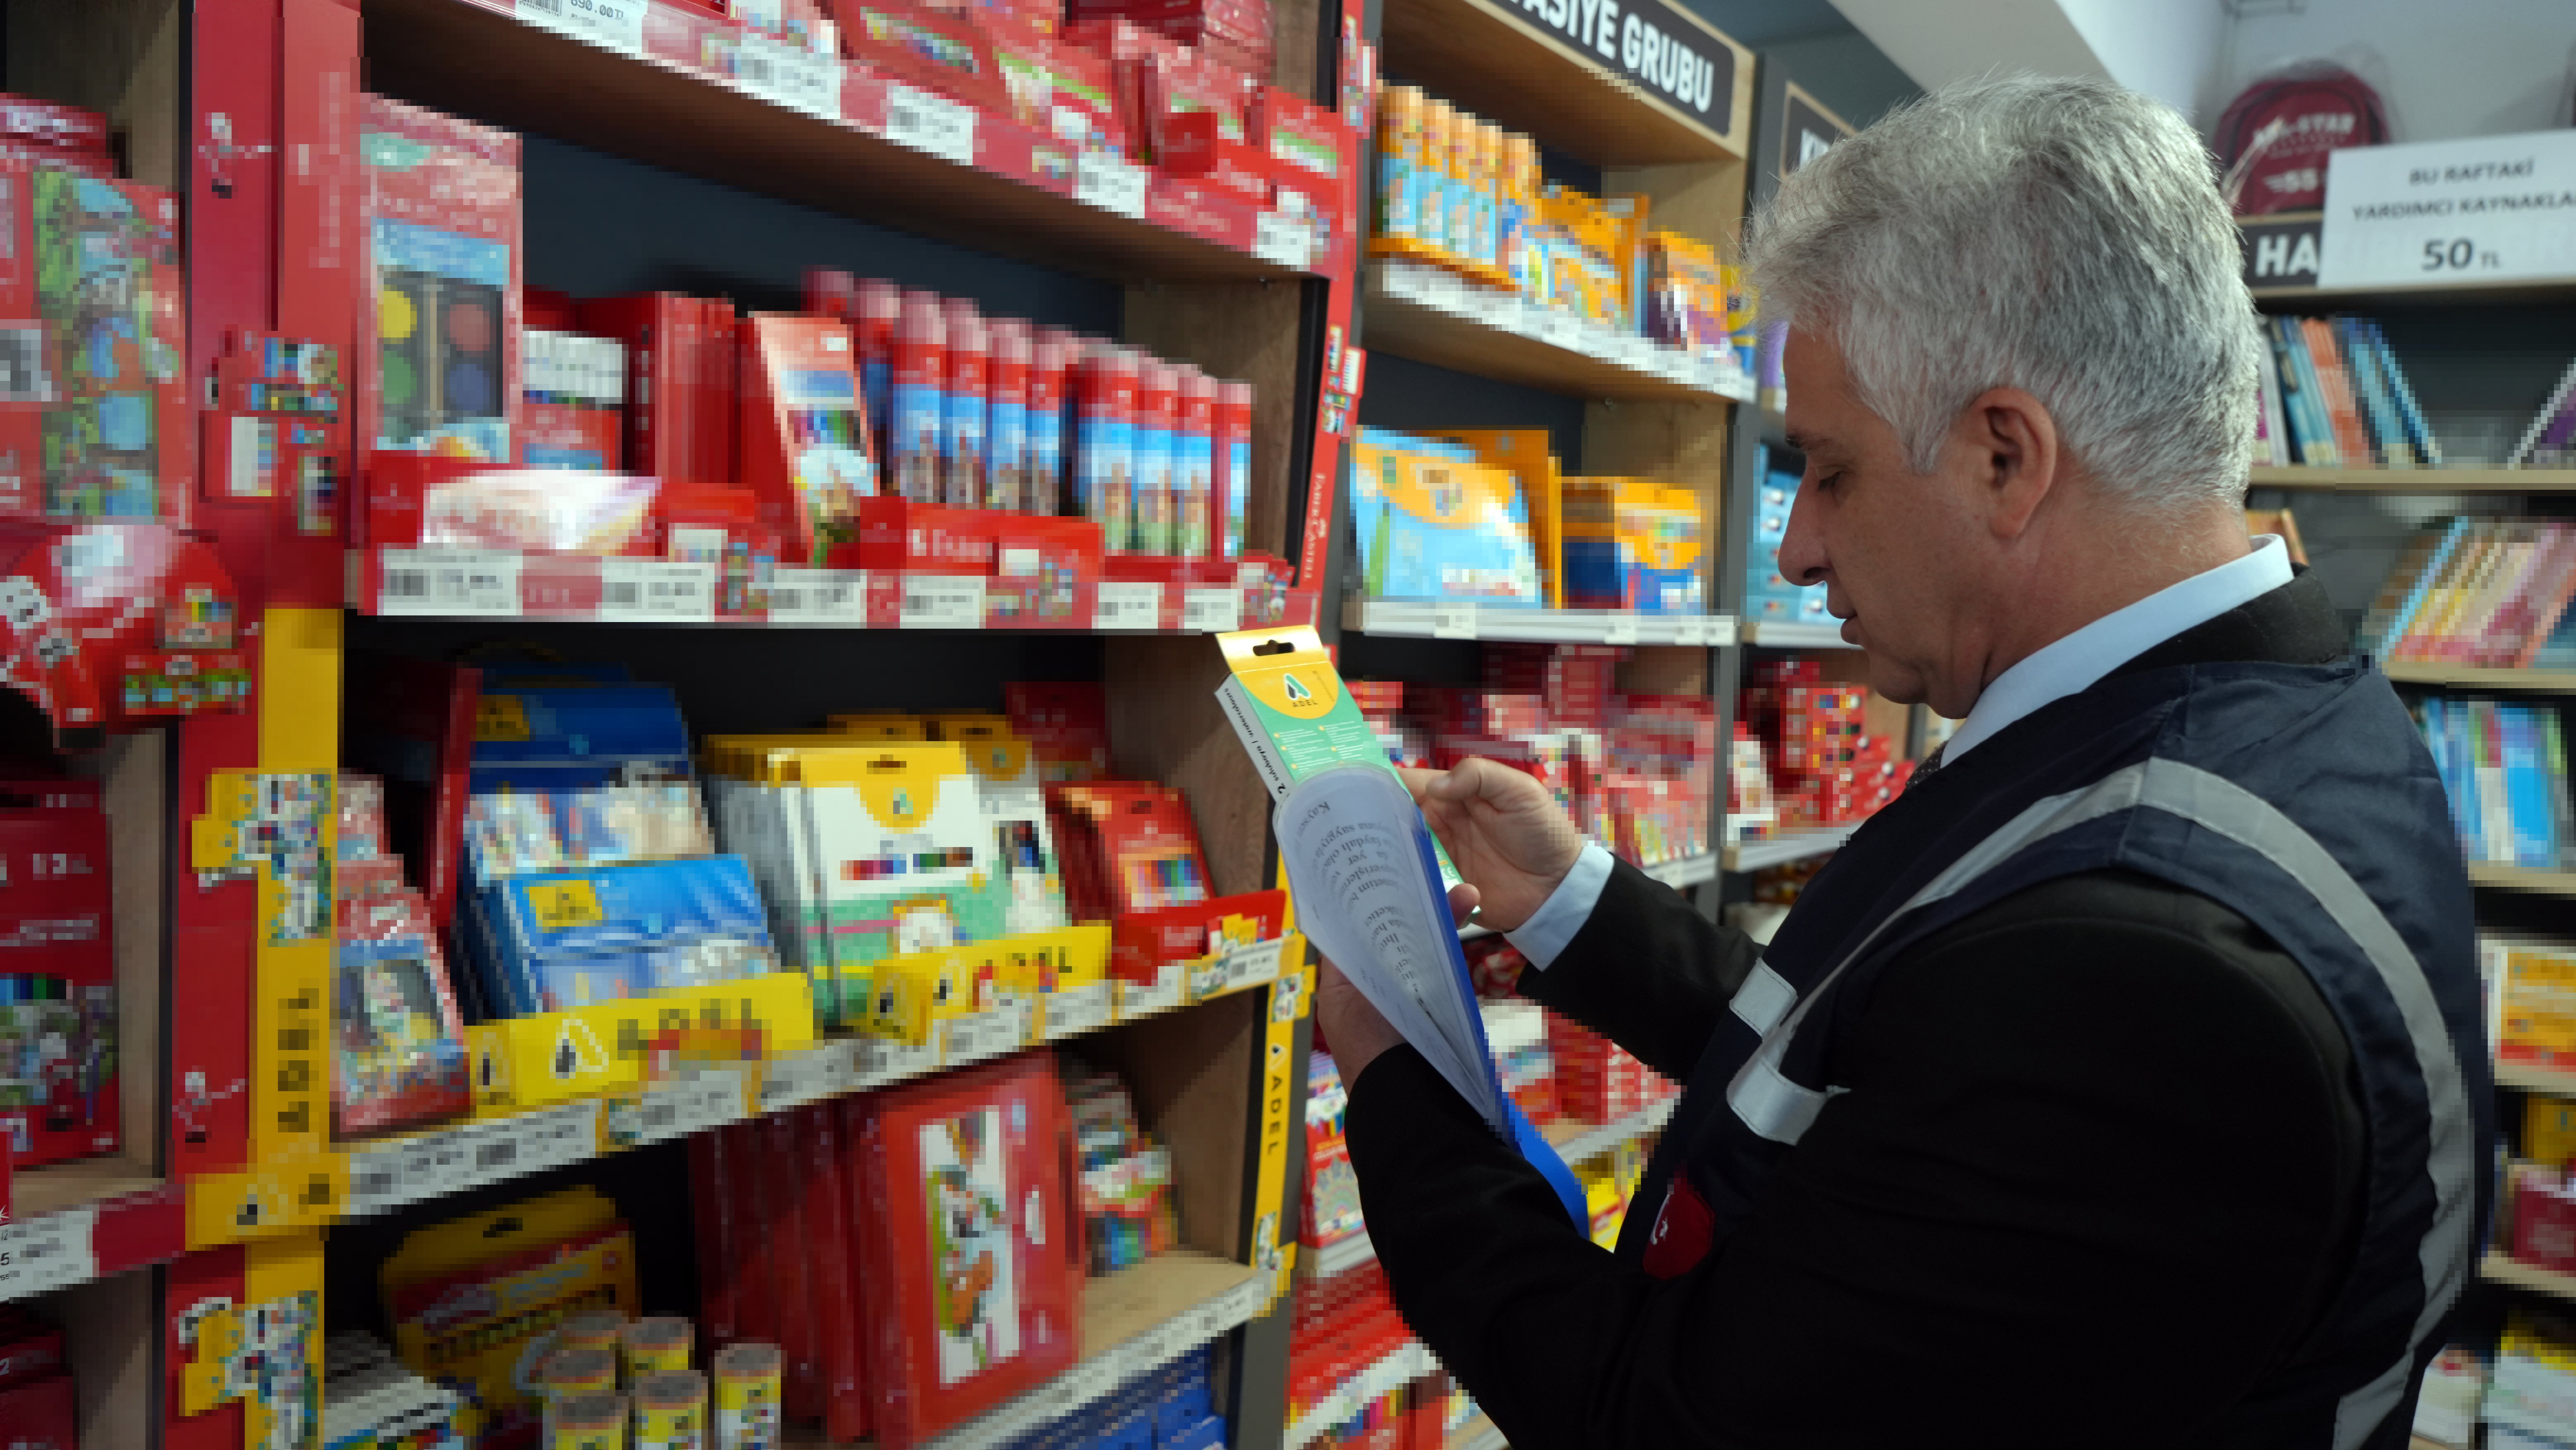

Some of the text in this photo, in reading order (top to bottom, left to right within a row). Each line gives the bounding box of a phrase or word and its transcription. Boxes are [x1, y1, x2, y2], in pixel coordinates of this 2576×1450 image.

[1622, 12, 1714, 113] GRUBU
[2408, 167, 2439, 186] BU
[2353, 199, 2454, 222] YARDIMCI
[2421, 236, 2474, 271] 50
[1292, 699, 1319, 708] ADEL
[1267, 1075, 1282, 1155] ADEL
